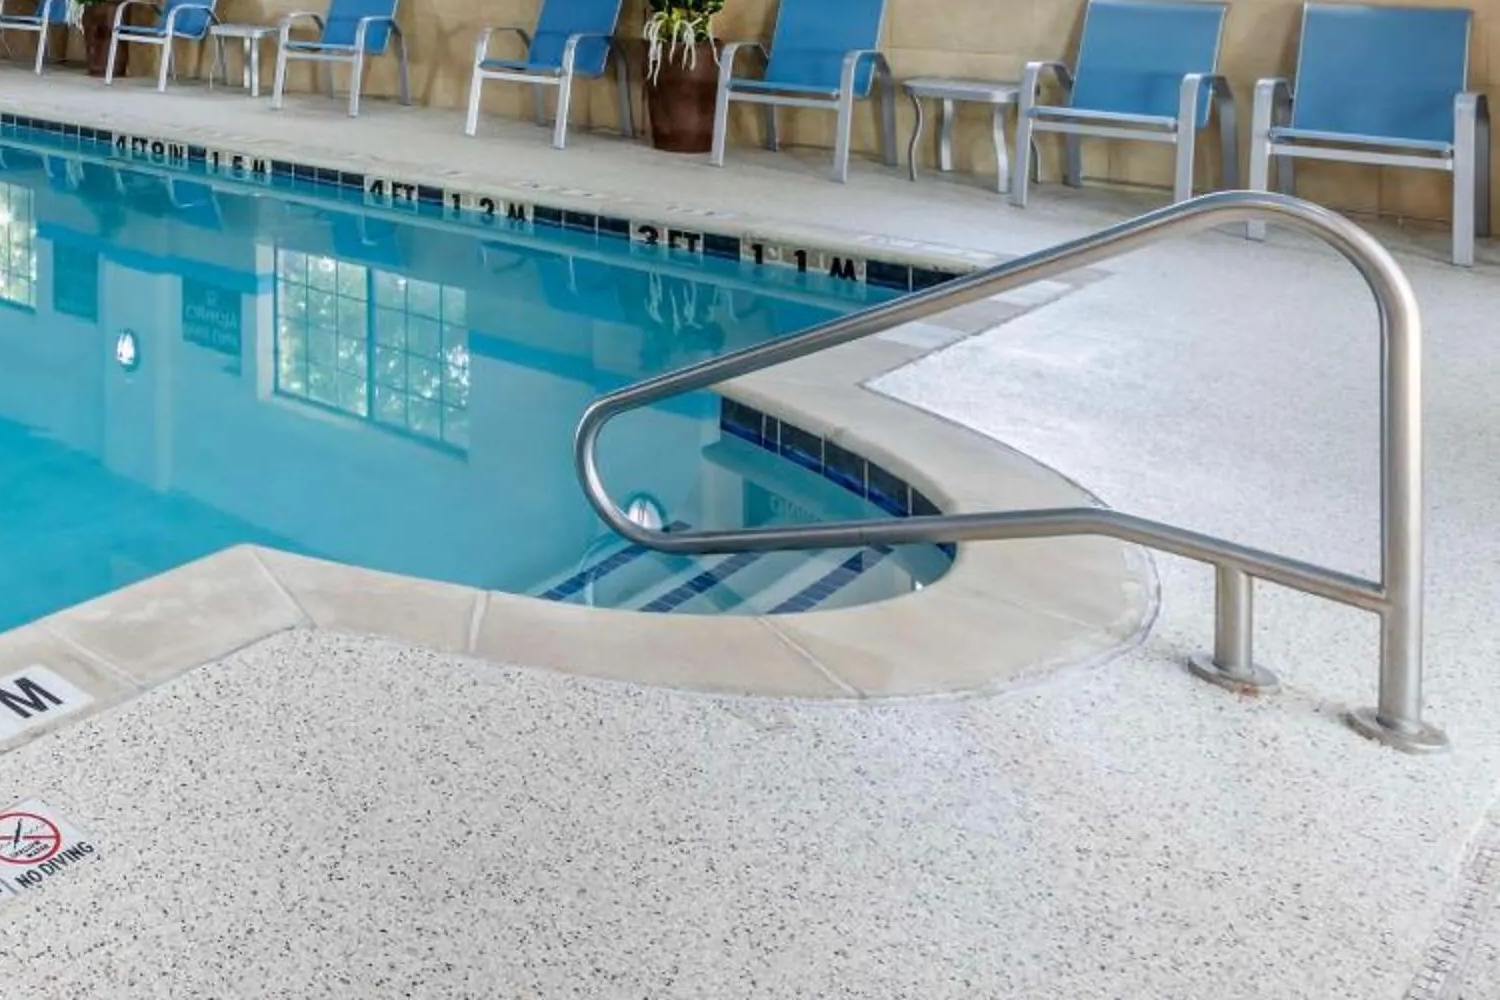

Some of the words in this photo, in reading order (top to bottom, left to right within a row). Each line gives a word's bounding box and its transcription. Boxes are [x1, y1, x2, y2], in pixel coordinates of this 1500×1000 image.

[392, 182, 415, 201] FT
[668, 230, 700, 253] FT
[829, 257, 857, 281] M
[15, 869, 43, 889] NO
[38, 841, 94, 877] DIVING
